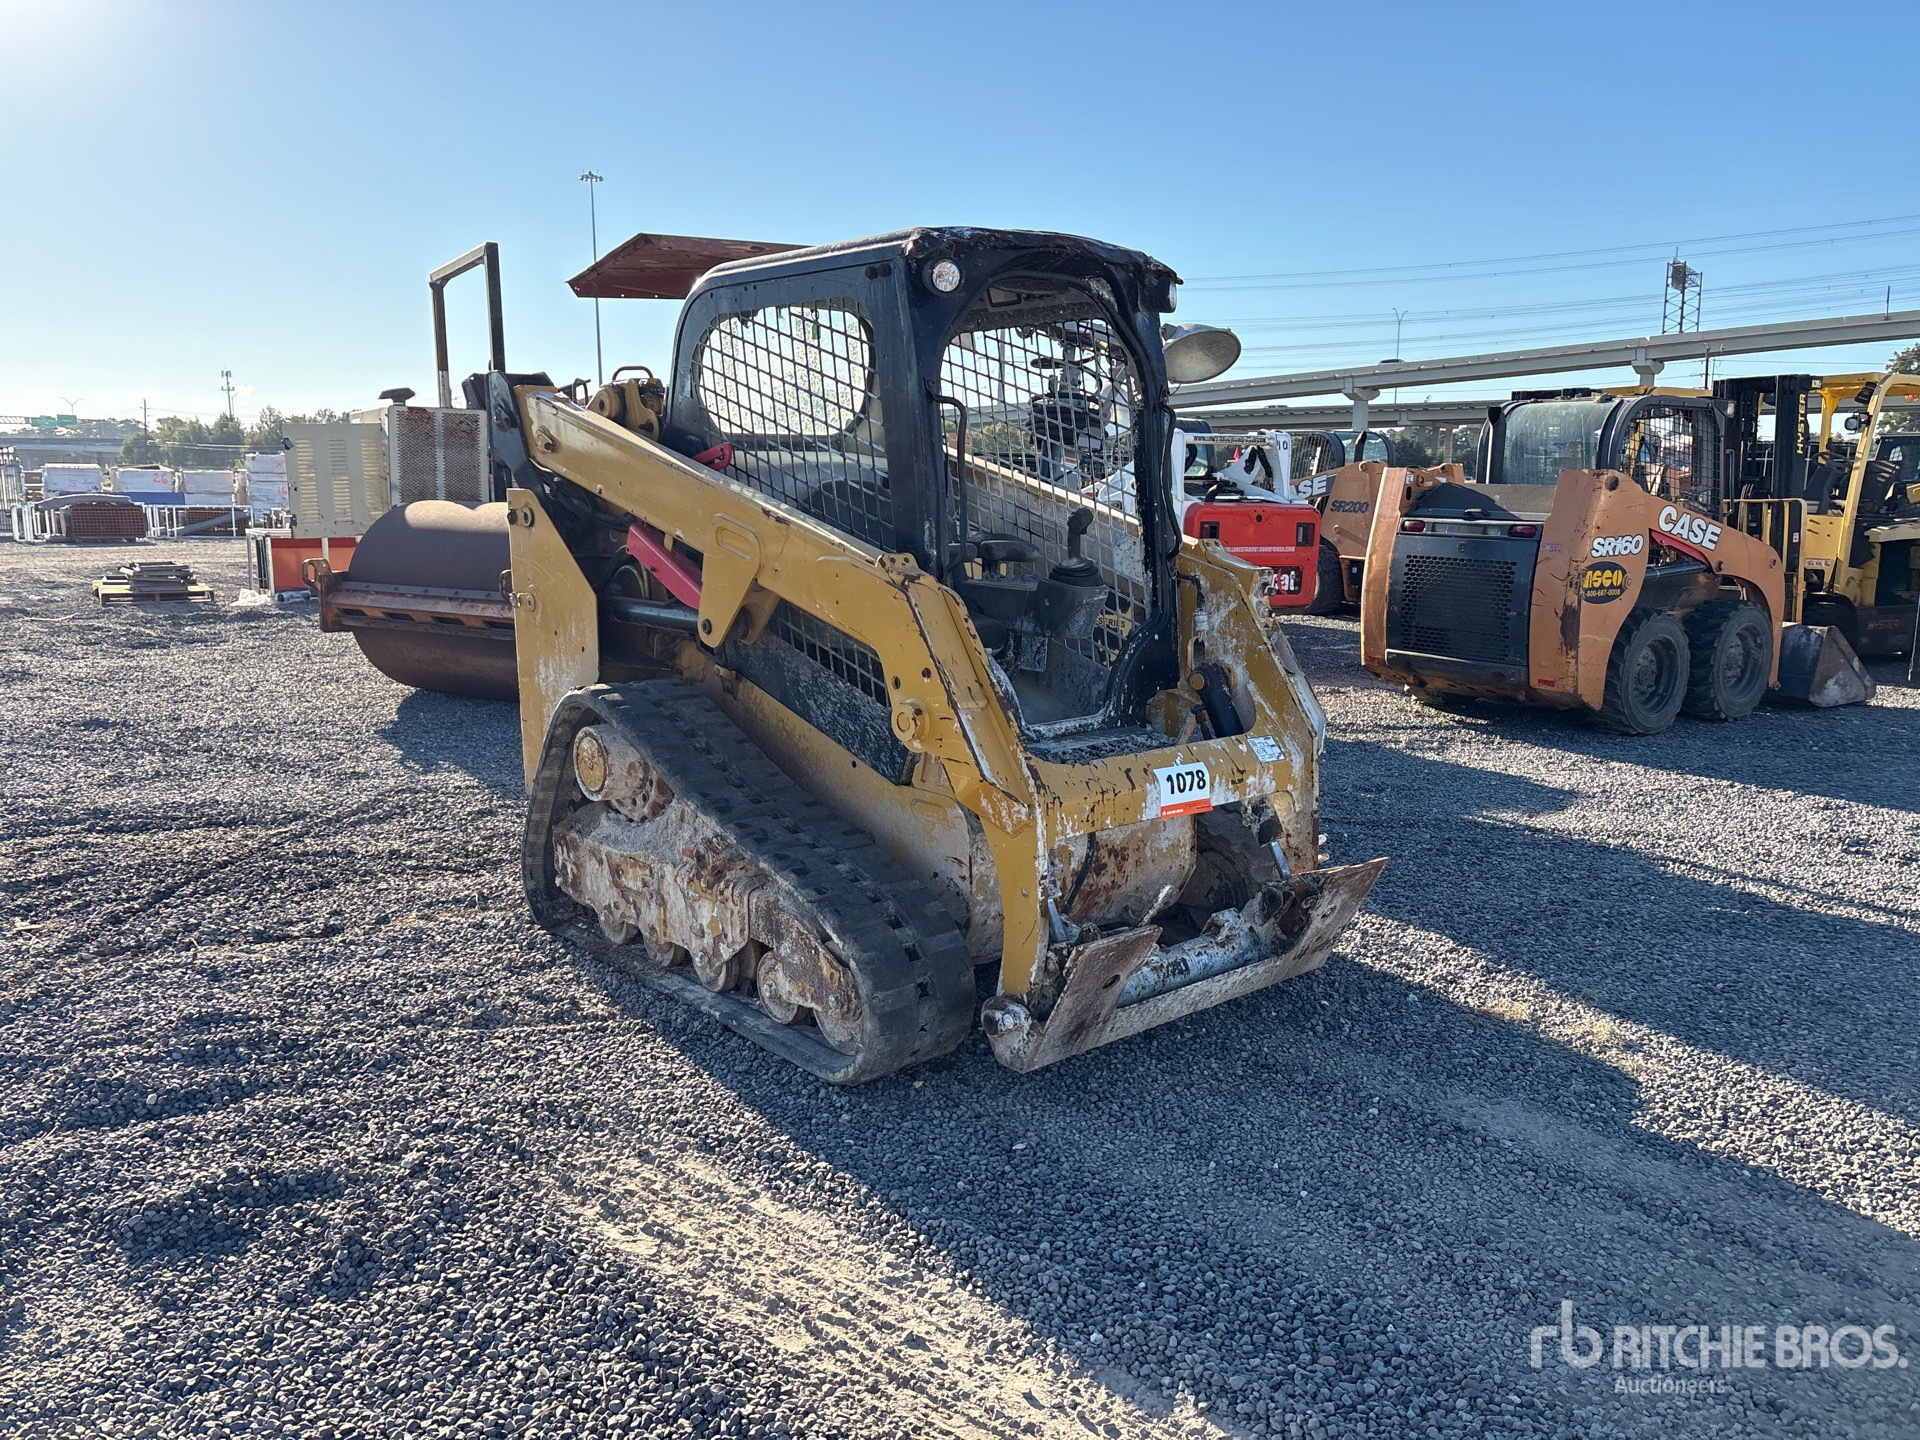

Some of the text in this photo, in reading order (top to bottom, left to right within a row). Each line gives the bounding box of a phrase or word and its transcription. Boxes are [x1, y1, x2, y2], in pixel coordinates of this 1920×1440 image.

[1797, 394, 1806, 454] HYSTER
[1330, 500, 1369, 513] SR200
[1659, 505, 1721, 551] CASE
[1591, 534, 1644, 558] SR160
[1098, 616, 1126, 629] SRIS
[1166, 769, 1207, 795] 1078
